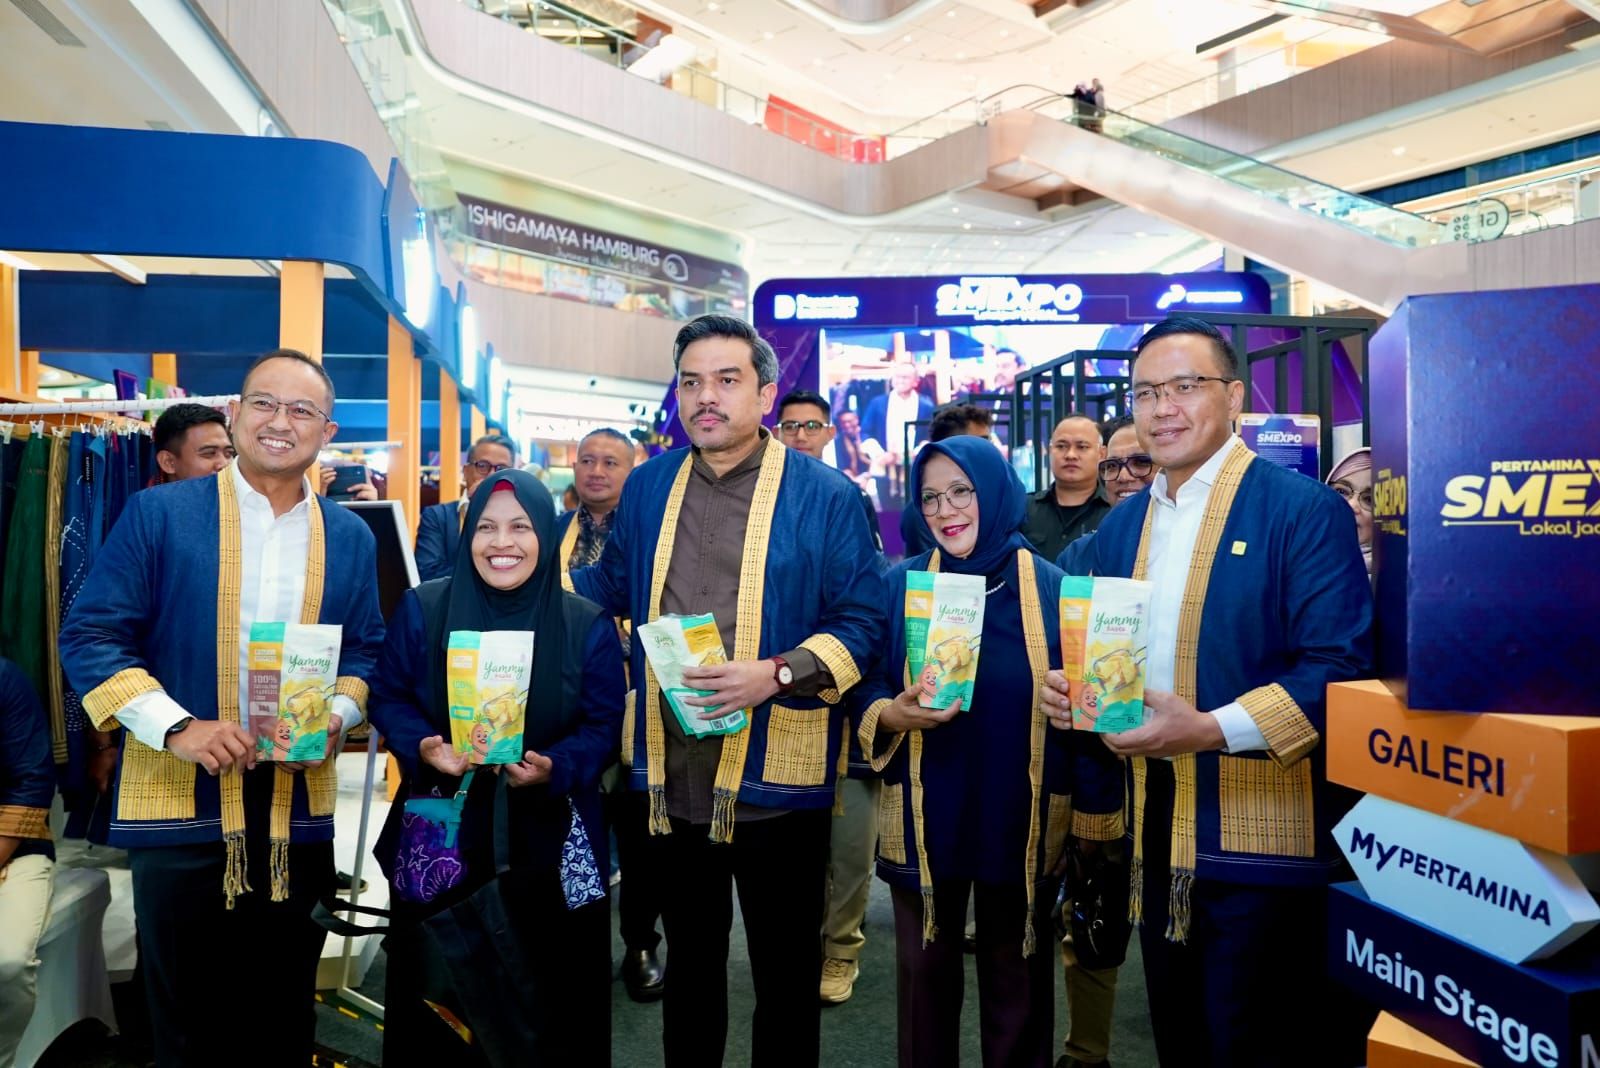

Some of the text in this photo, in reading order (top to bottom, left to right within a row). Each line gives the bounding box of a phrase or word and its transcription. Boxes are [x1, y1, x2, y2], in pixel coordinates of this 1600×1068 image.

[468, 203, 579, 248] ISHIGAMAYA
[582, 232, 660, 267] HAMBURG
[1257, 431, 1302, 443] SMEXPO
[1491, 459, 1586, 473] PERTAMINA
[1519, 520, 1573, 535] Lokal
[937, 604, 978, 623] Yammy
[1094, 612, 1142, 633] Yammy
[288, 654, 332, 673] Yammy
[484, 661, 525, 679] Yammy
[1368, 728, 1505, 798] GALERI
[1346, 928, 1559, 1068] Main Stage
